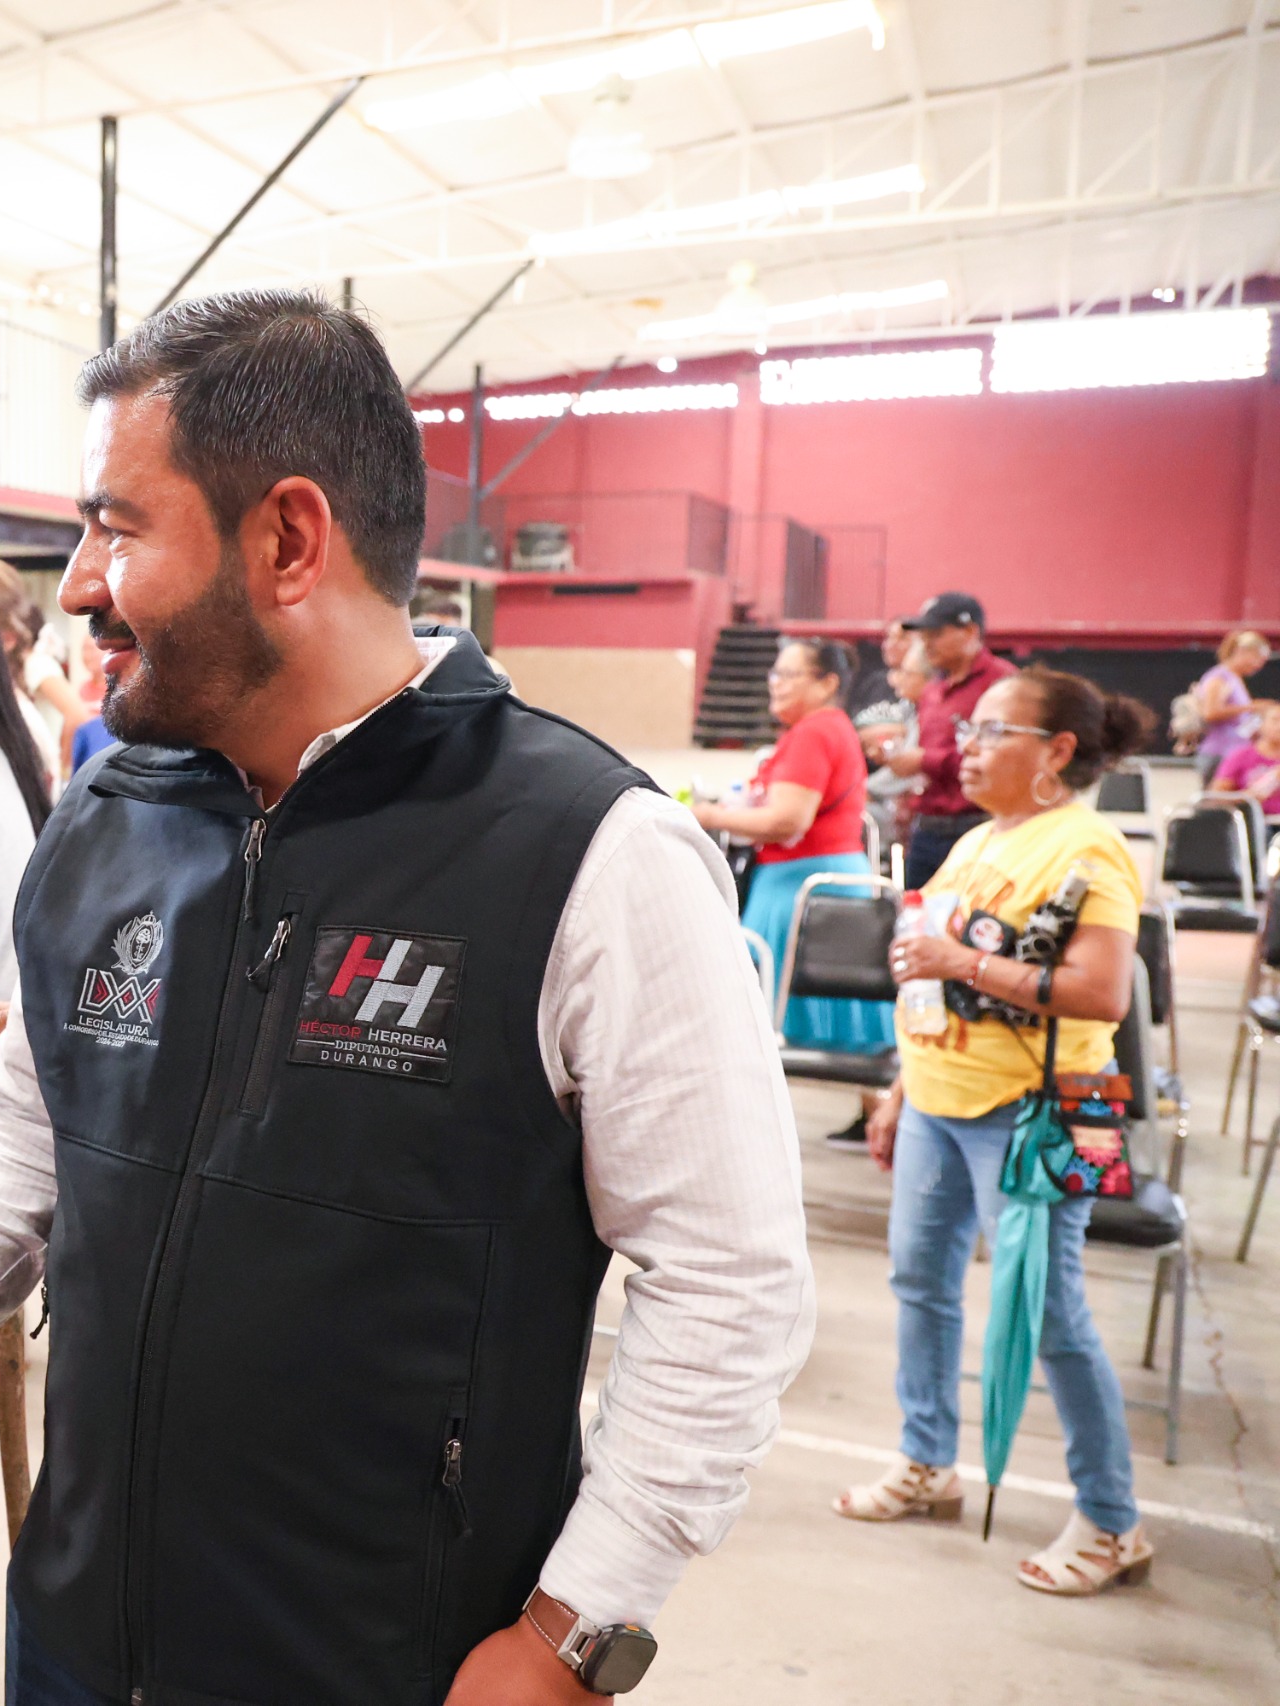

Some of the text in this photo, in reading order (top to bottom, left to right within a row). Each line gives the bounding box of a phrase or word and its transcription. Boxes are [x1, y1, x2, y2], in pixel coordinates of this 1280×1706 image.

[78, 1015, 150, 1038] LEGISLATURA
[299, 1019, 448, 1052] HÉCTOR HERRERA
[334, 1039, 400, 1057] DIPUTADO
[320, 1050, 413, 1072] DURANGO
